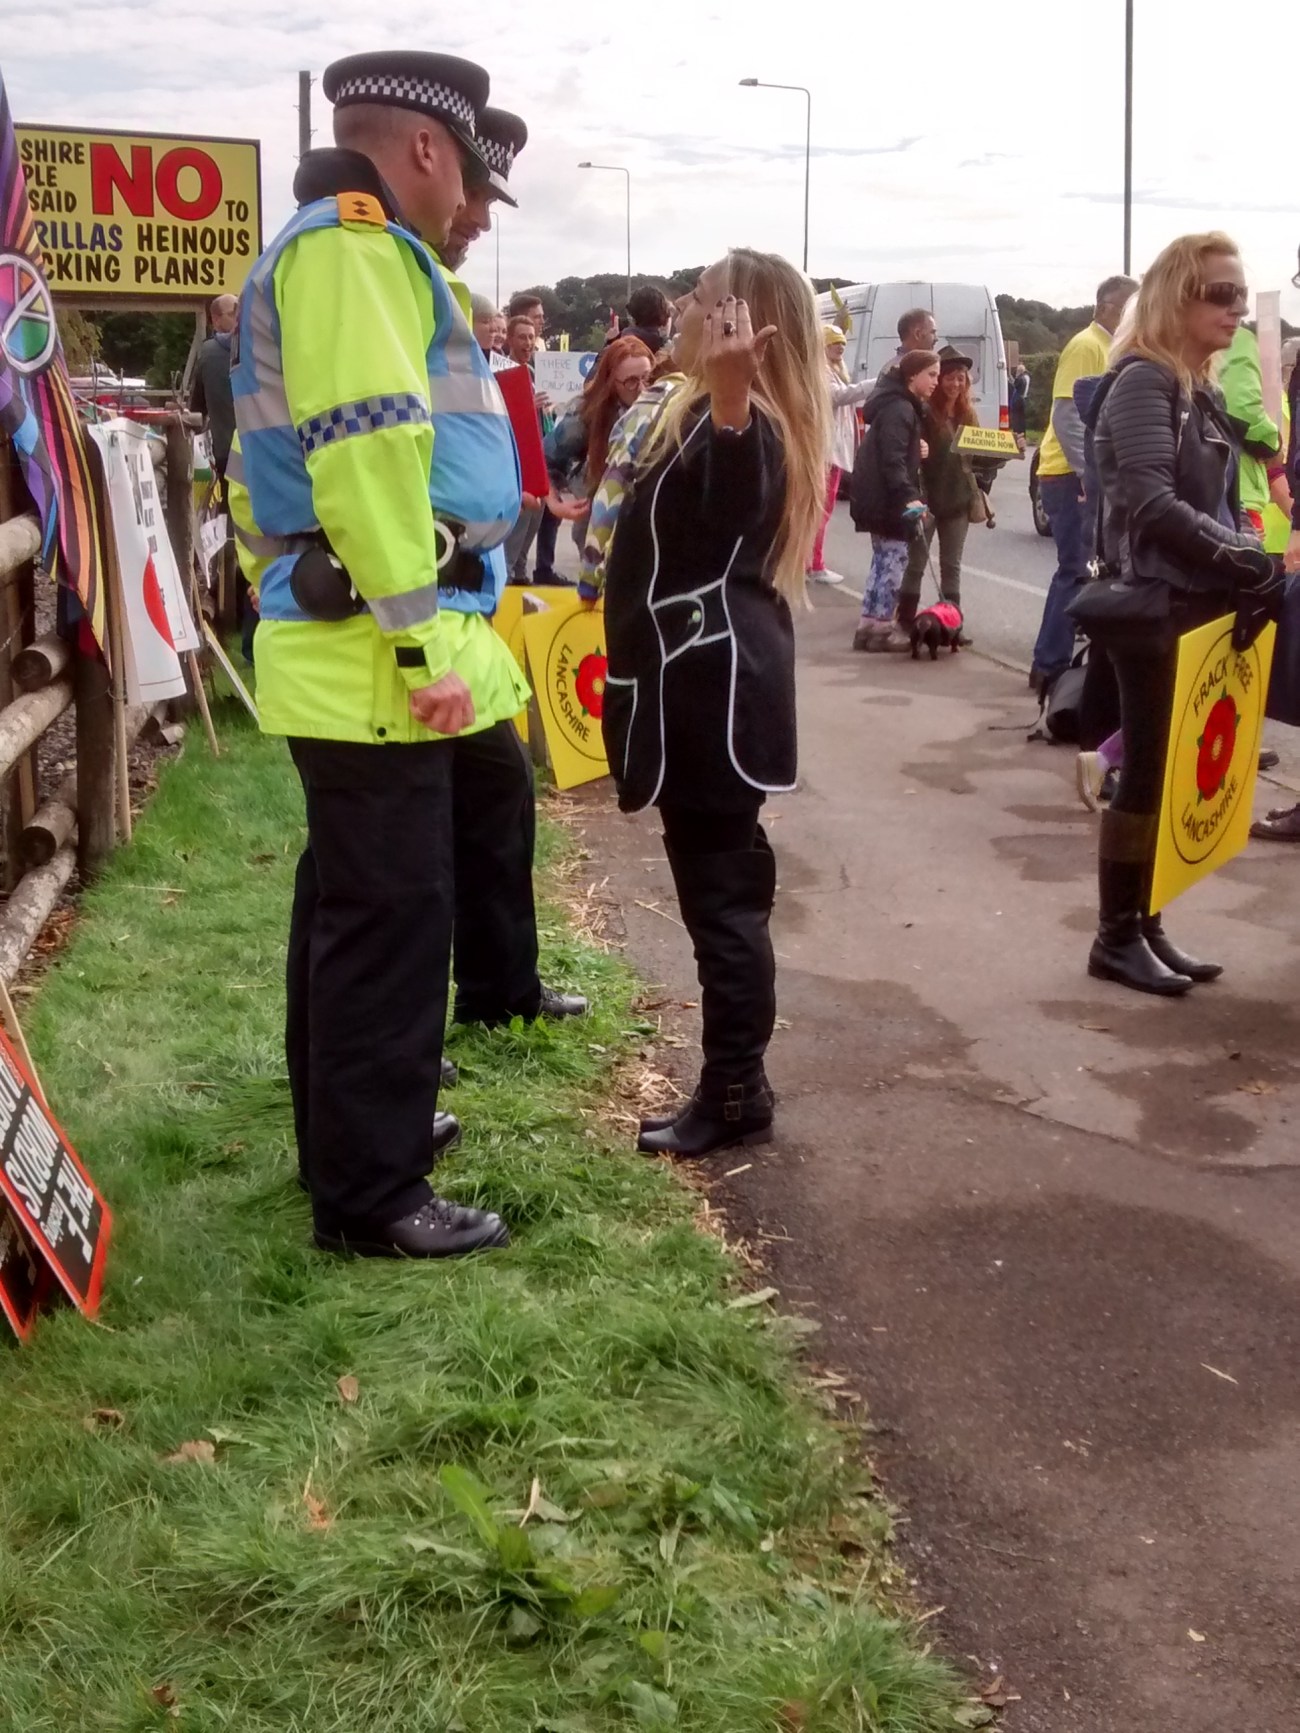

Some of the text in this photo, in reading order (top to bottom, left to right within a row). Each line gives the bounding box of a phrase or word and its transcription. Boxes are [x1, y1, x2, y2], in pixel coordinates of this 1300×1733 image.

[21, 138, 85, 165] SHIRE
[22, 164, 58, 188] PLE
[28, 142, 249, 222] SAID NO TO
[34, 220, 250, 256] RILLAS HEINOUS
[134, 255, 225, 286] PLANS!
[540, 359, 571, 369] THERE
[963, 437, 996, 447] FRACKING
[556, 643, 590, 742] LANCASHIRE
[1193, 653, 1229, 718] FRACK
[1181, 774, 1238, 843] LANCASHIRE
[13, 1095, 60, 1194] WORD
[56, 1151, 94, 1230] THE
